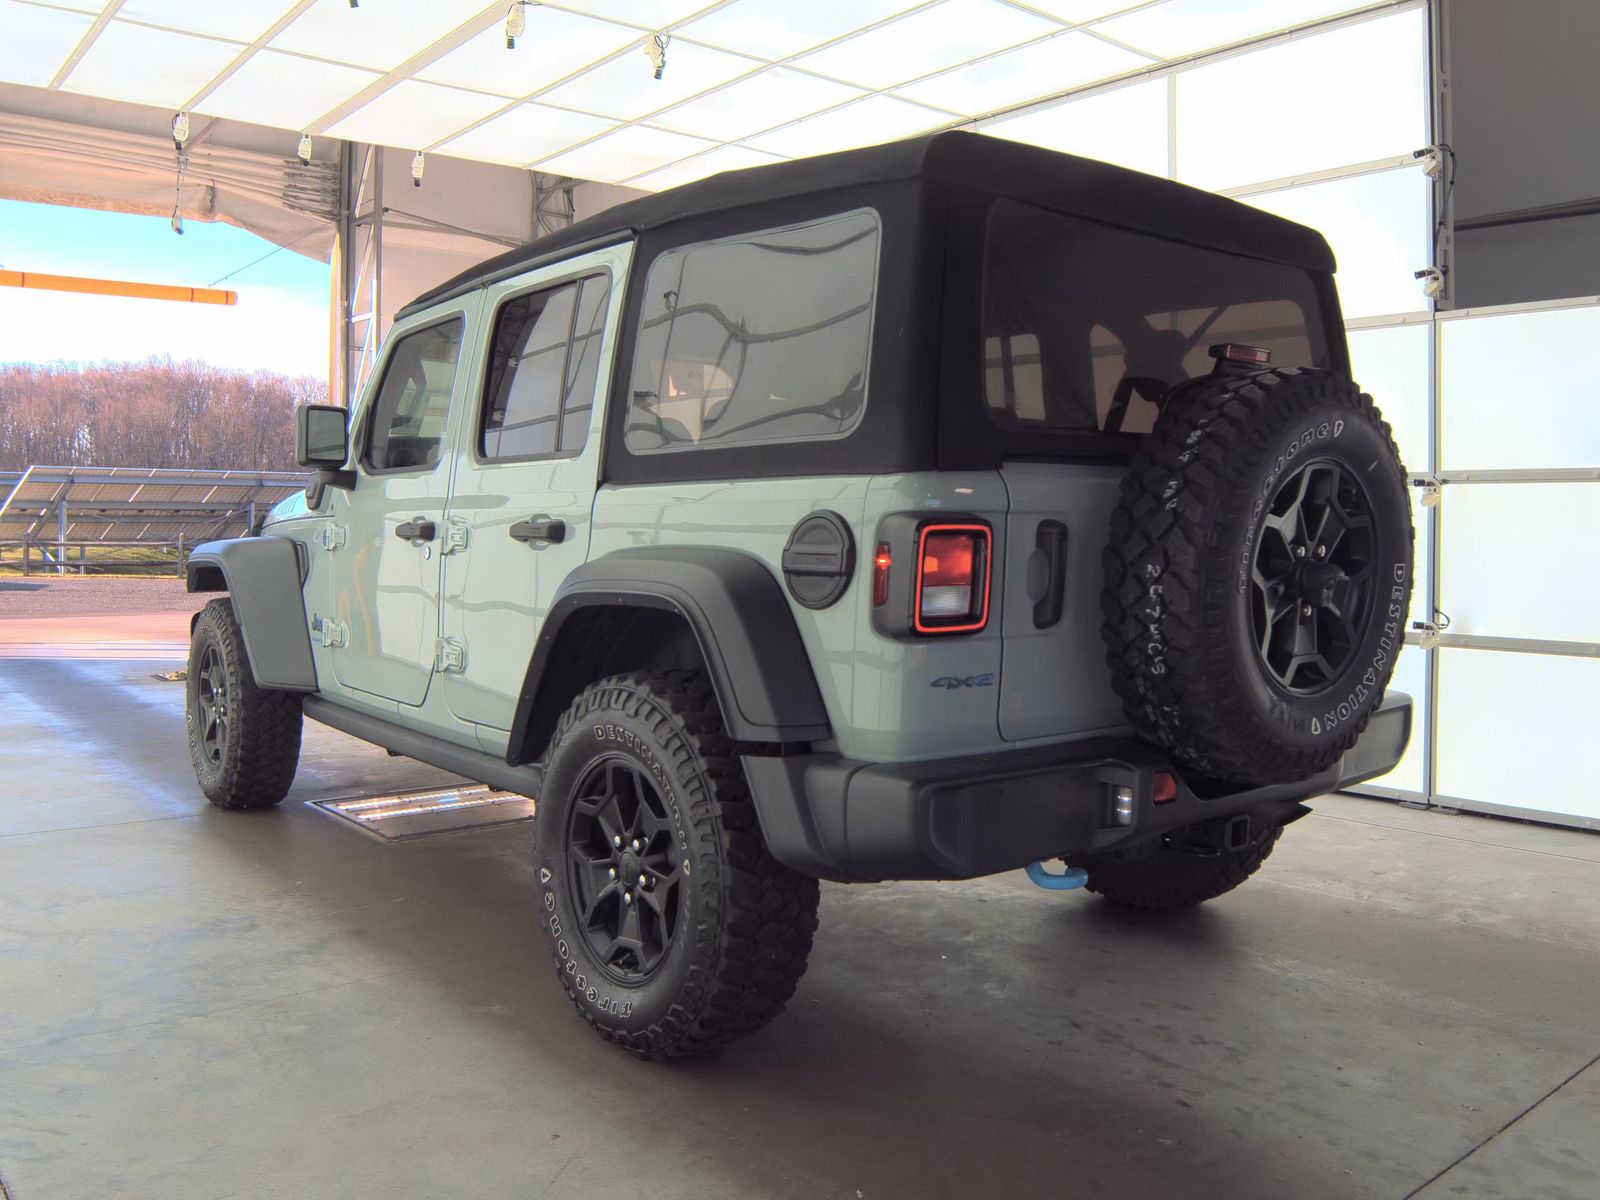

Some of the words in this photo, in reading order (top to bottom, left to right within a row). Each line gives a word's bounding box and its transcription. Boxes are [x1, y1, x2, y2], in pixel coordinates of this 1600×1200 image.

[1324, 563, 1406, 731] DESTINATION
[593, 725, 688, 850] DESTINATION
[544, 892, 632, 1018] Firestone
